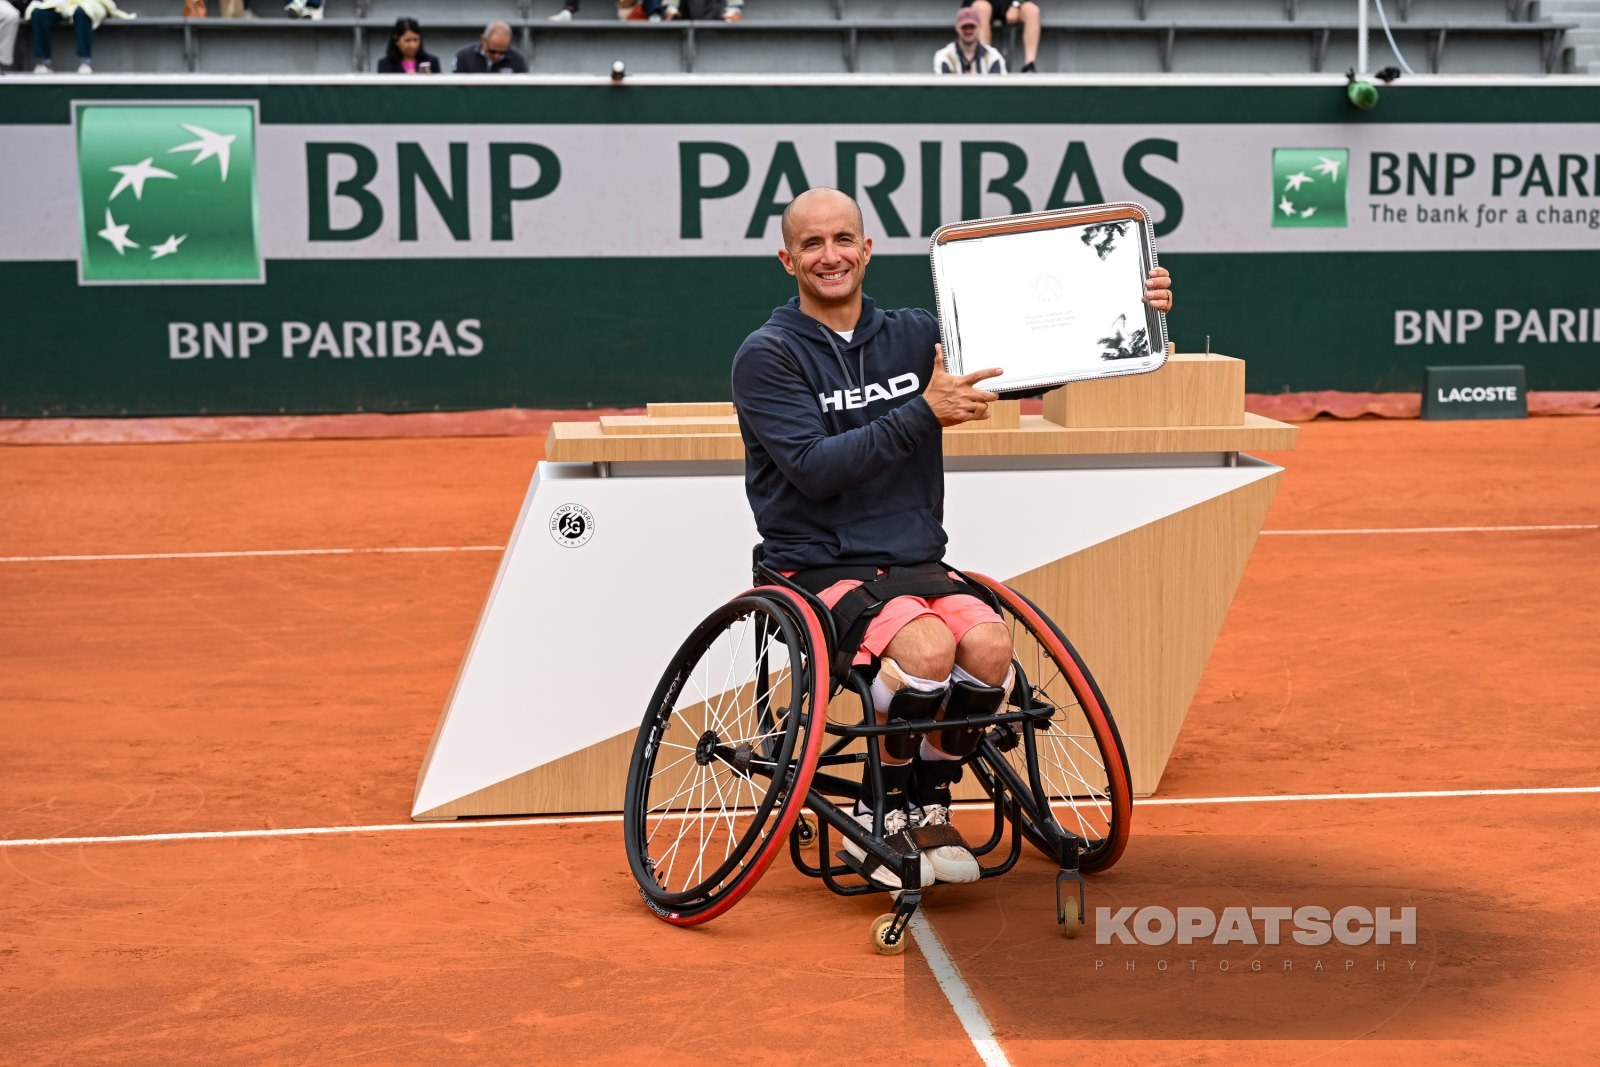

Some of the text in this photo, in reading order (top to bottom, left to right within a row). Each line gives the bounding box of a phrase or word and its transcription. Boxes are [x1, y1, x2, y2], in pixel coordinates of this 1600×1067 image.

[305, 138, 1184, 242] BNP PARIBAS
[1369, 152, 1476, 196] BNP
[1369, 203, 1408, 223] The
[1416, 203, 1469, 223] bank
[1475, 203, 1509, 229] for
[1516, 208, 1528, 224] a
[168, 318, 484, 360] BNP PARIBAS
[1394, 309, 1483, 345] BNP
[818, 372, 920, 413] HEAD
[1437, 386, 1518, 403] LACOSTE
[552, 505, 593, 531] ROLAND GARROS
